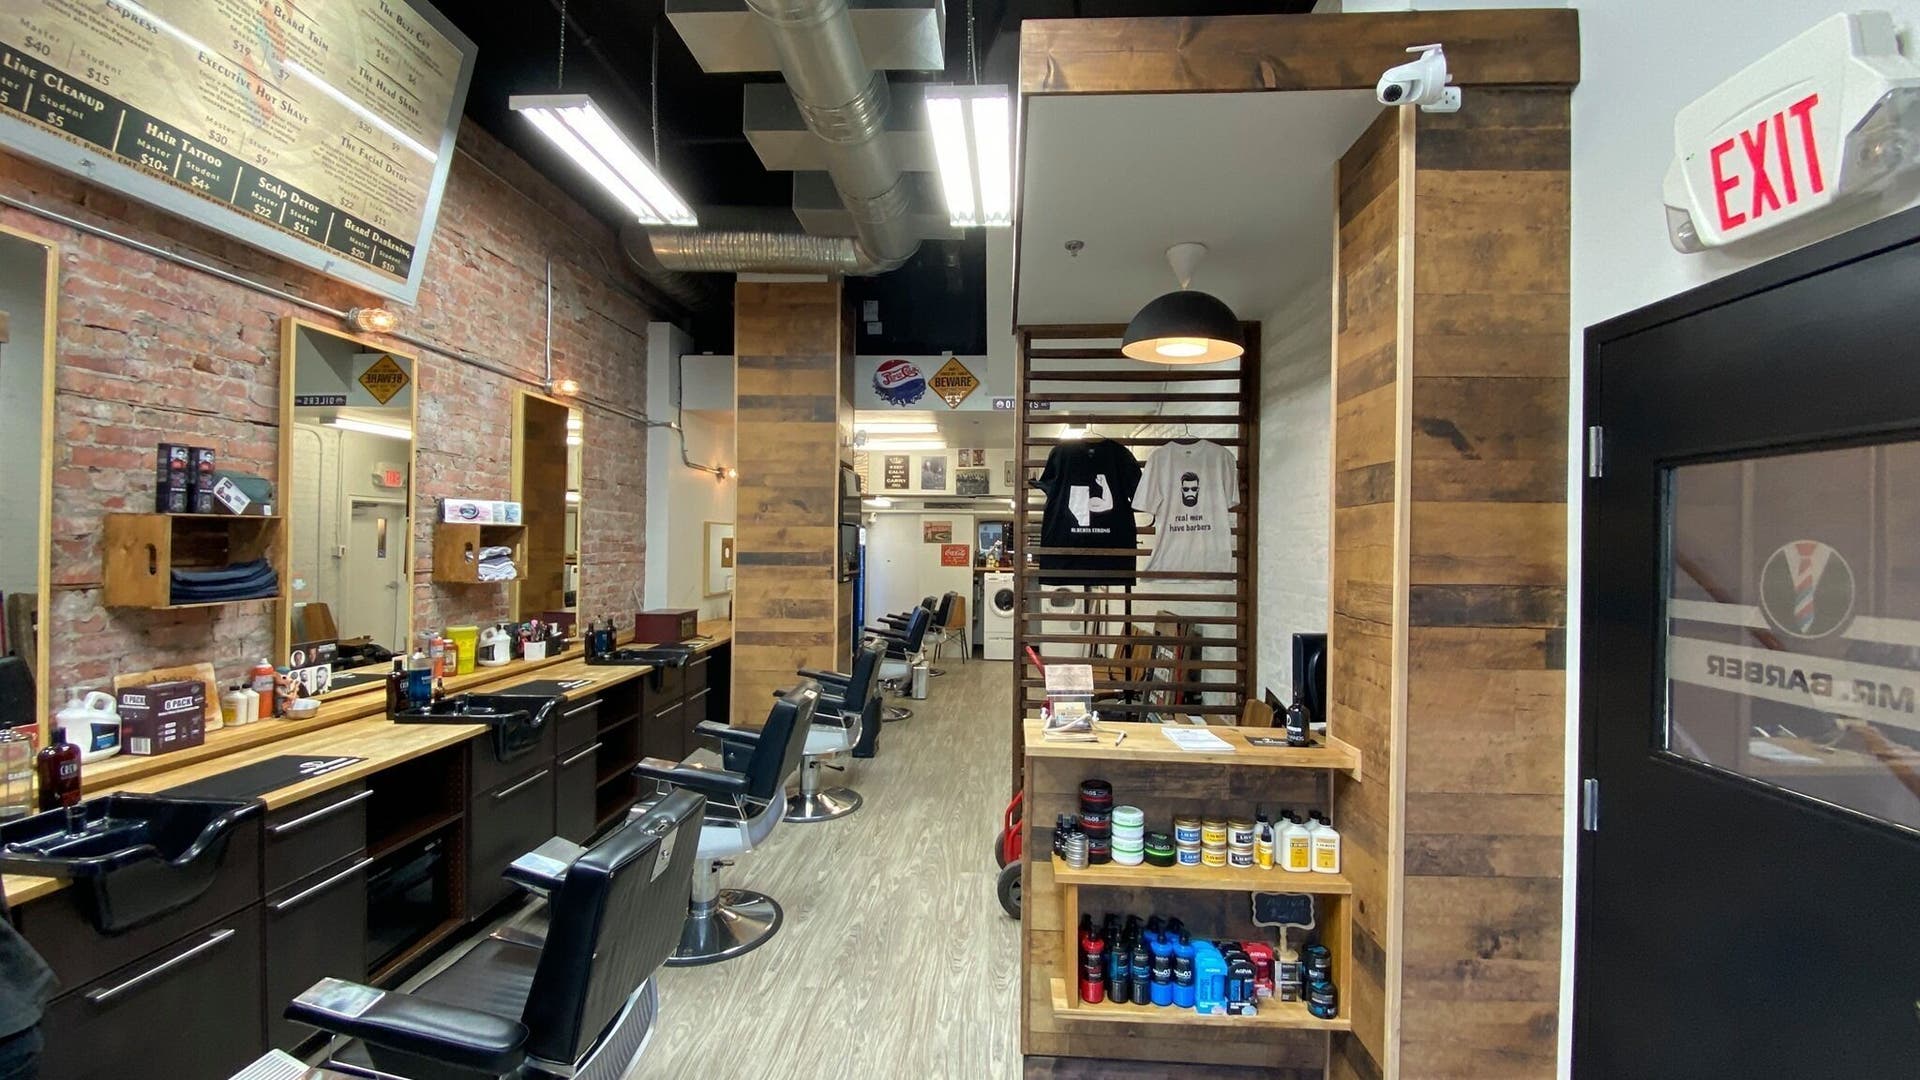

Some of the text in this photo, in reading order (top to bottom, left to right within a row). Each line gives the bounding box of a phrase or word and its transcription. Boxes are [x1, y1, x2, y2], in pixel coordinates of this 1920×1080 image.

[20, 17, 61, 43] Master
[24, 36, 51, 56] $40
[233, 39, 252, 56] $19
[80, 49, 122, 76] Student
[86, 67, 111, 87] $15
[39, 93, 86, 120] Student
[47, 111, 65, 127] $5
[205, 115, 236, 134] Master
[208, 129, 228, 146] $30
[136, 138, 171, 159] Master
[140, 153, 169, 173] $10+
[256, 154, 268, 166] $9
[1710, 92, 1825, 232] EXIT
[185, 160, 221, 182] Student
[190, 175, 211, 190] $4+
[251, 190, 278, 208] Master
[253, 203, 272, 219] $22
[288, 208, 318, 227] Student
[293, 221, 310, 235] $11
[350, 247, 366, 260] $20
[381, 261, 395, 272] $10
[935, 376, 972, 388] BEWARE
[1175, 514, 1188, 522] real
[1169, 524, 1211, 533] have barbers
[172, 697, 192, 708] PACK
